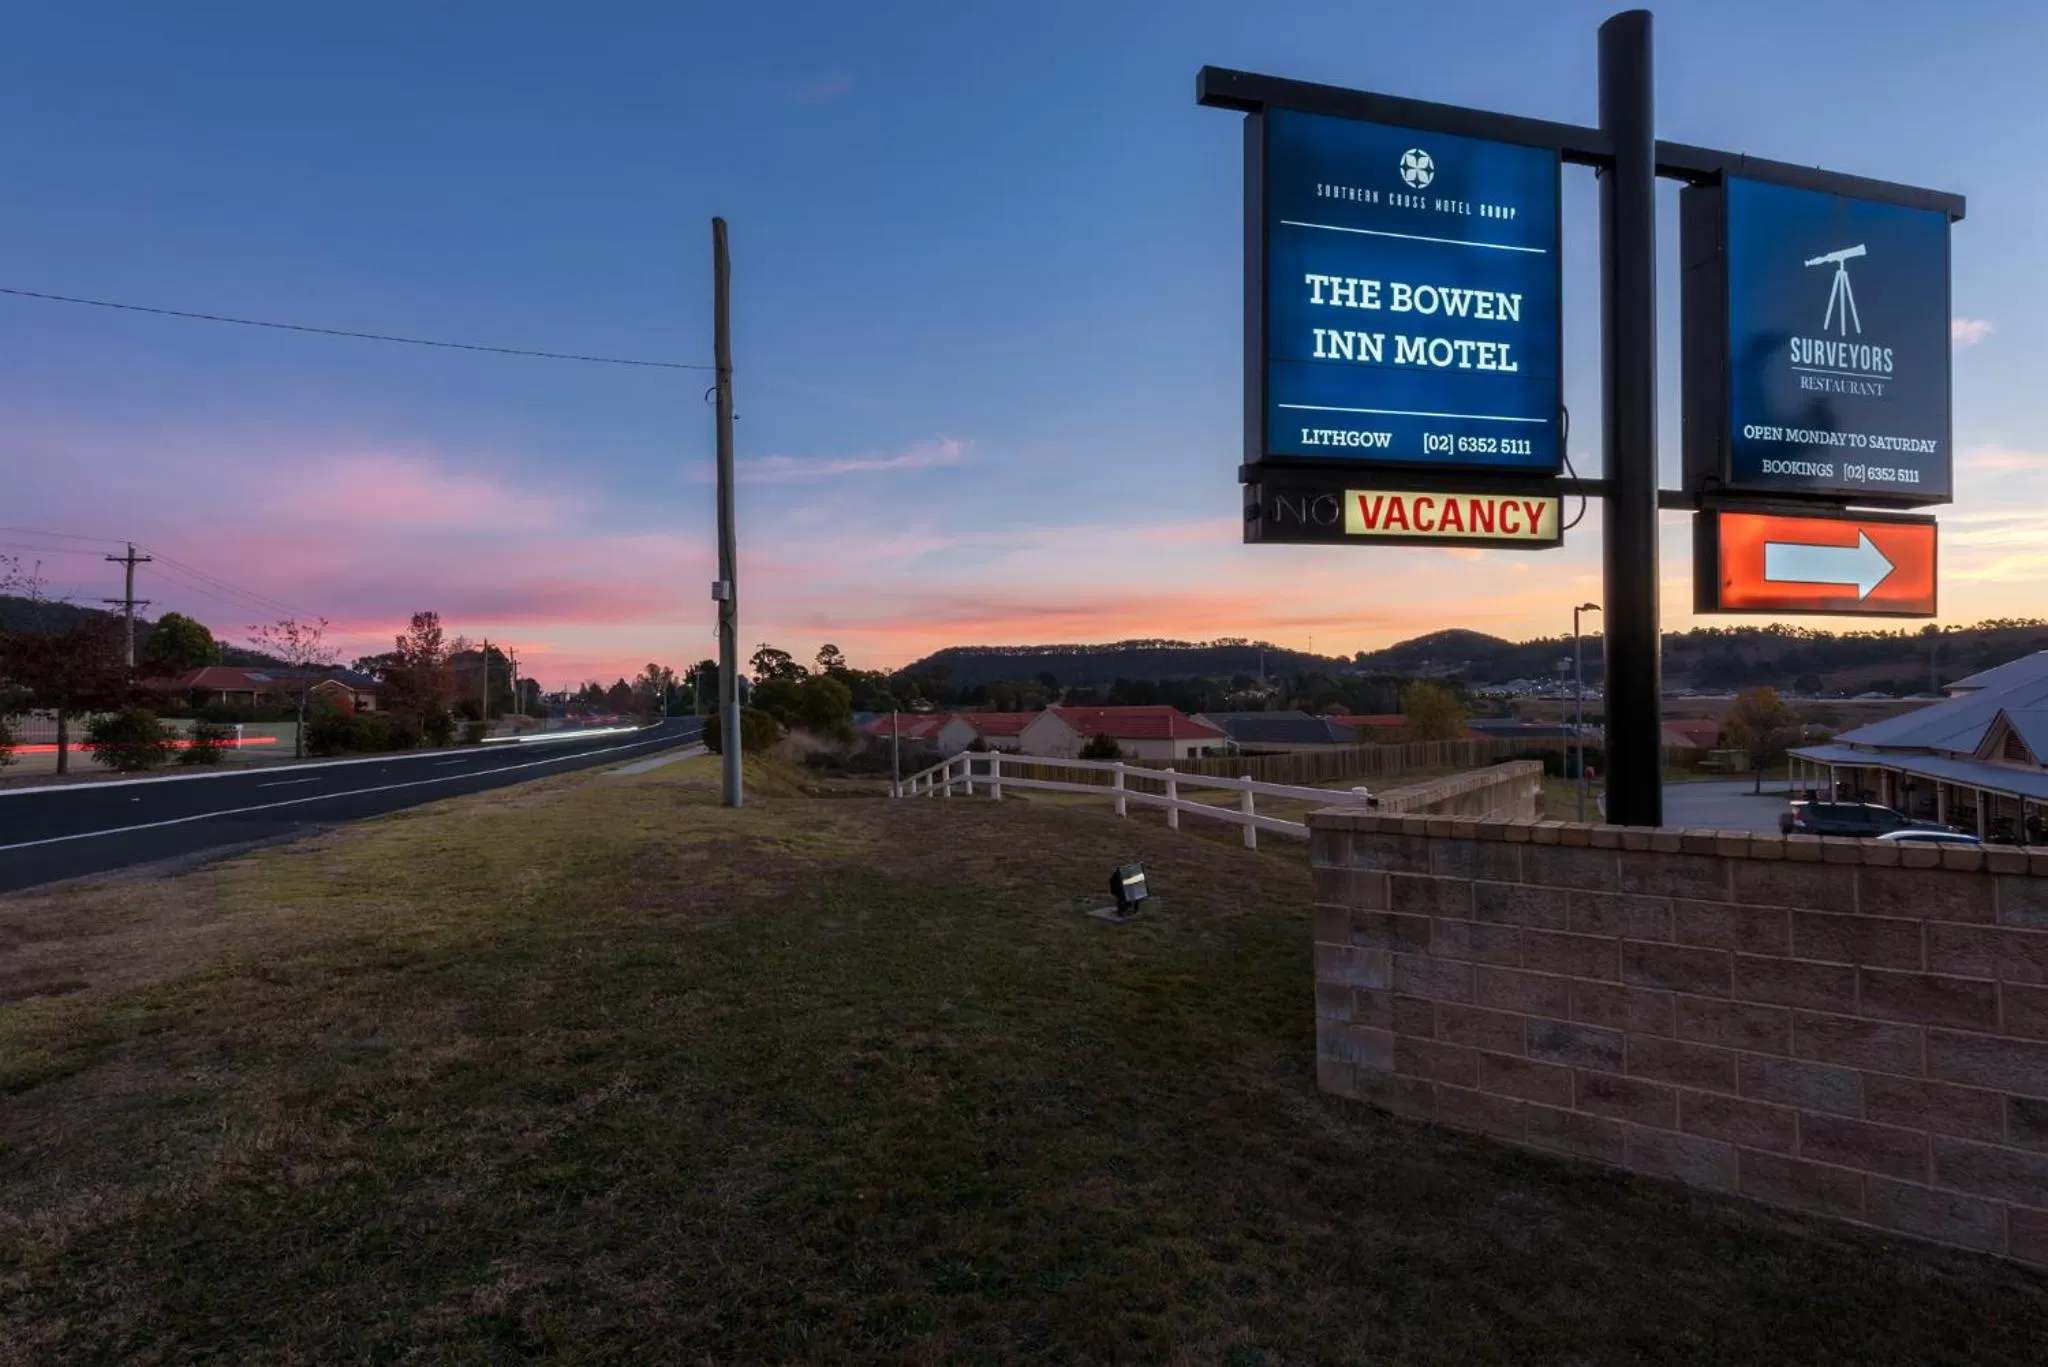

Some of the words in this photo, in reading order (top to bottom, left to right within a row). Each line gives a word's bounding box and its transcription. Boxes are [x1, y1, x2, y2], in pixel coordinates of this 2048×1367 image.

[1389, 193, 1426, 210] CROSS
[1480, 204, 1516, 220] GROUP
[1305, 274, 1381, 310] THE
[1390, 282, 1522, 321] BOWEN
[1313, 328, 1385, 363] INN
[1394, 335, 1518, 372] MOTEL
[1790, 337, 1894, 373] SURVEYORS
[1800, 375, 1885, 397] RESTAURANT
[1301, 428, 1393, 448] LITHGOW
[1458, 437, 1497, 453] 6352
[1501, 438, 1531, 455] 5111
[1744, 425, 1783, 441] OPEN
[1785, 428, 1848, 446] MONDAY
[1848, 433, 1867, 447] TO
[1869, 435, 1937, 453] SATURDAY
[1762, 459, 1834, 478] BOOKINGS
[1867, 466, 1896, 481] 6352
[1898, 468, 1920, 483] 5111
[1274, 493, 1340, 526] NO
[1358, 494, 1546, 535] VACANCY
